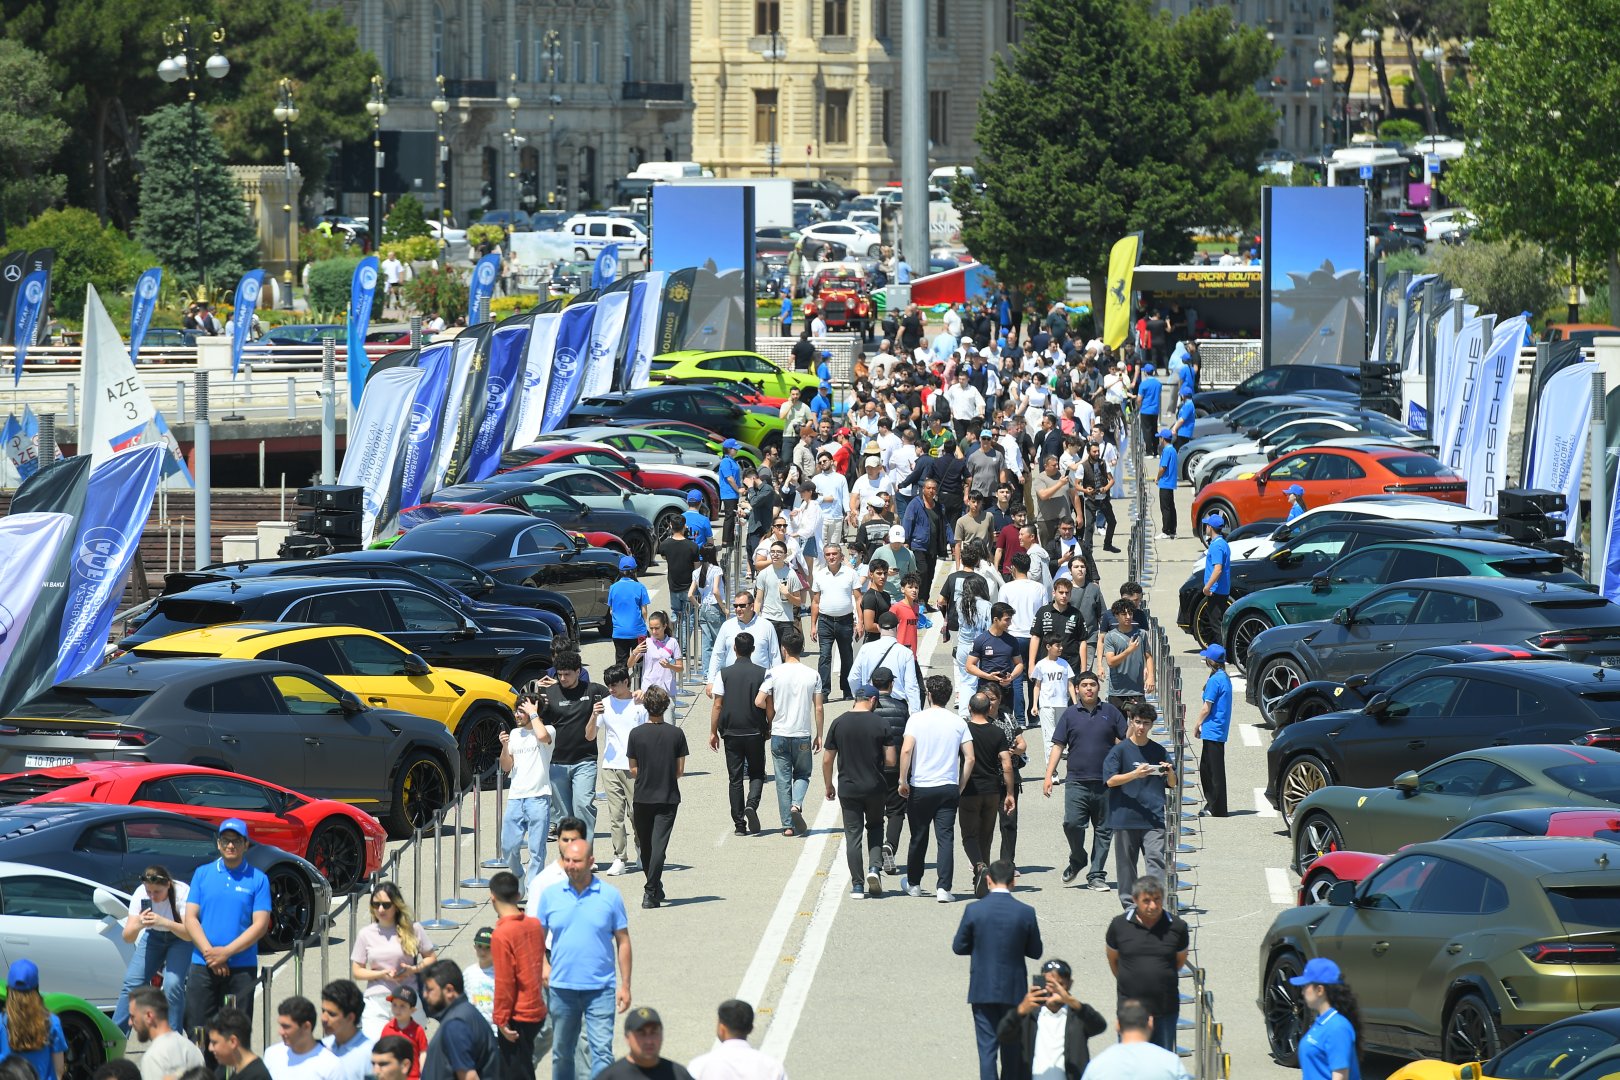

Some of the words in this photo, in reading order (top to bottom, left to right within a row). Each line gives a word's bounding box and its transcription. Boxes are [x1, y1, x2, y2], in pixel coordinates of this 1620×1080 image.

[1177, 272, 1226, 281] SUPERCAR
[107, 376, 140, 402] AZE
[123, 401, 138, 420] 3
[12, 447, 36, 466] AZE
[445, 459, 458, 484] ZAR
